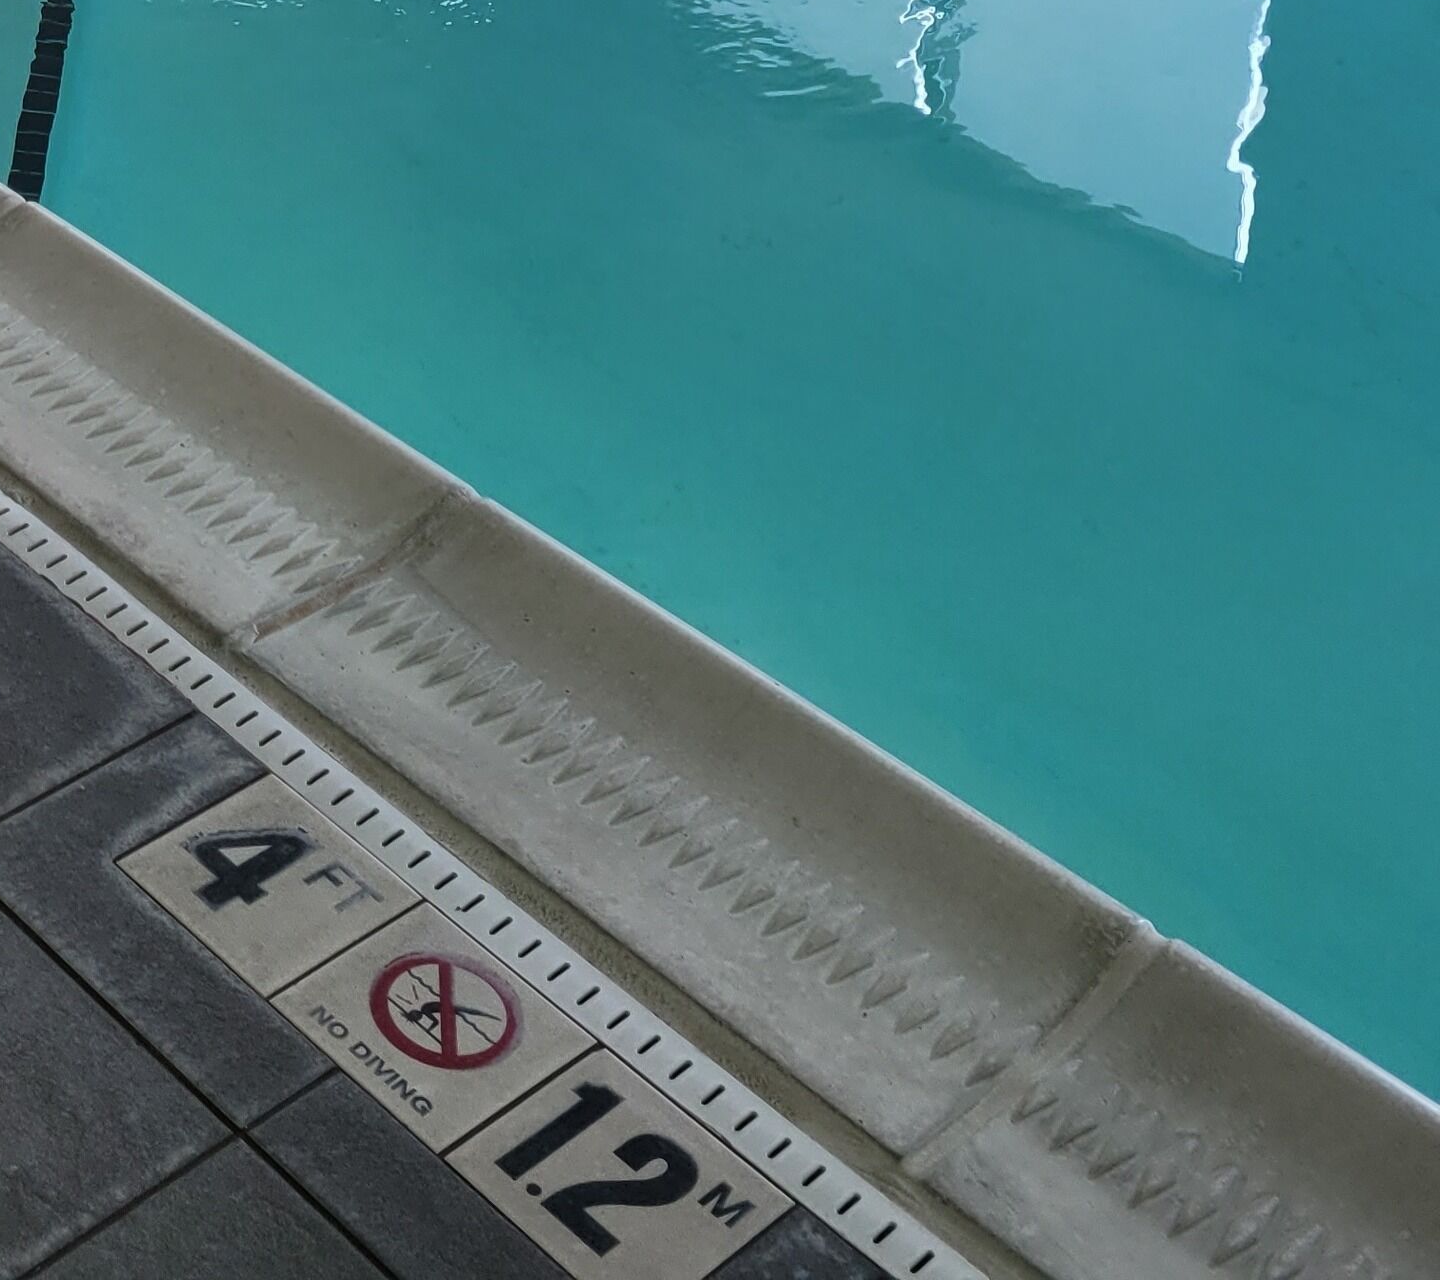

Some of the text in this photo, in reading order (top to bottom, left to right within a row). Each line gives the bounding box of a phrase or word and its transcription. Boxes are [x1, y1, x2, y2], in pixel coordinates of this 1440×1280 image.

[190, 827, 386, 916] 4 FT
[309, 1003, 435, 1119] NO DIVING
[493, 1080, 756, 1259] 1.2 M
